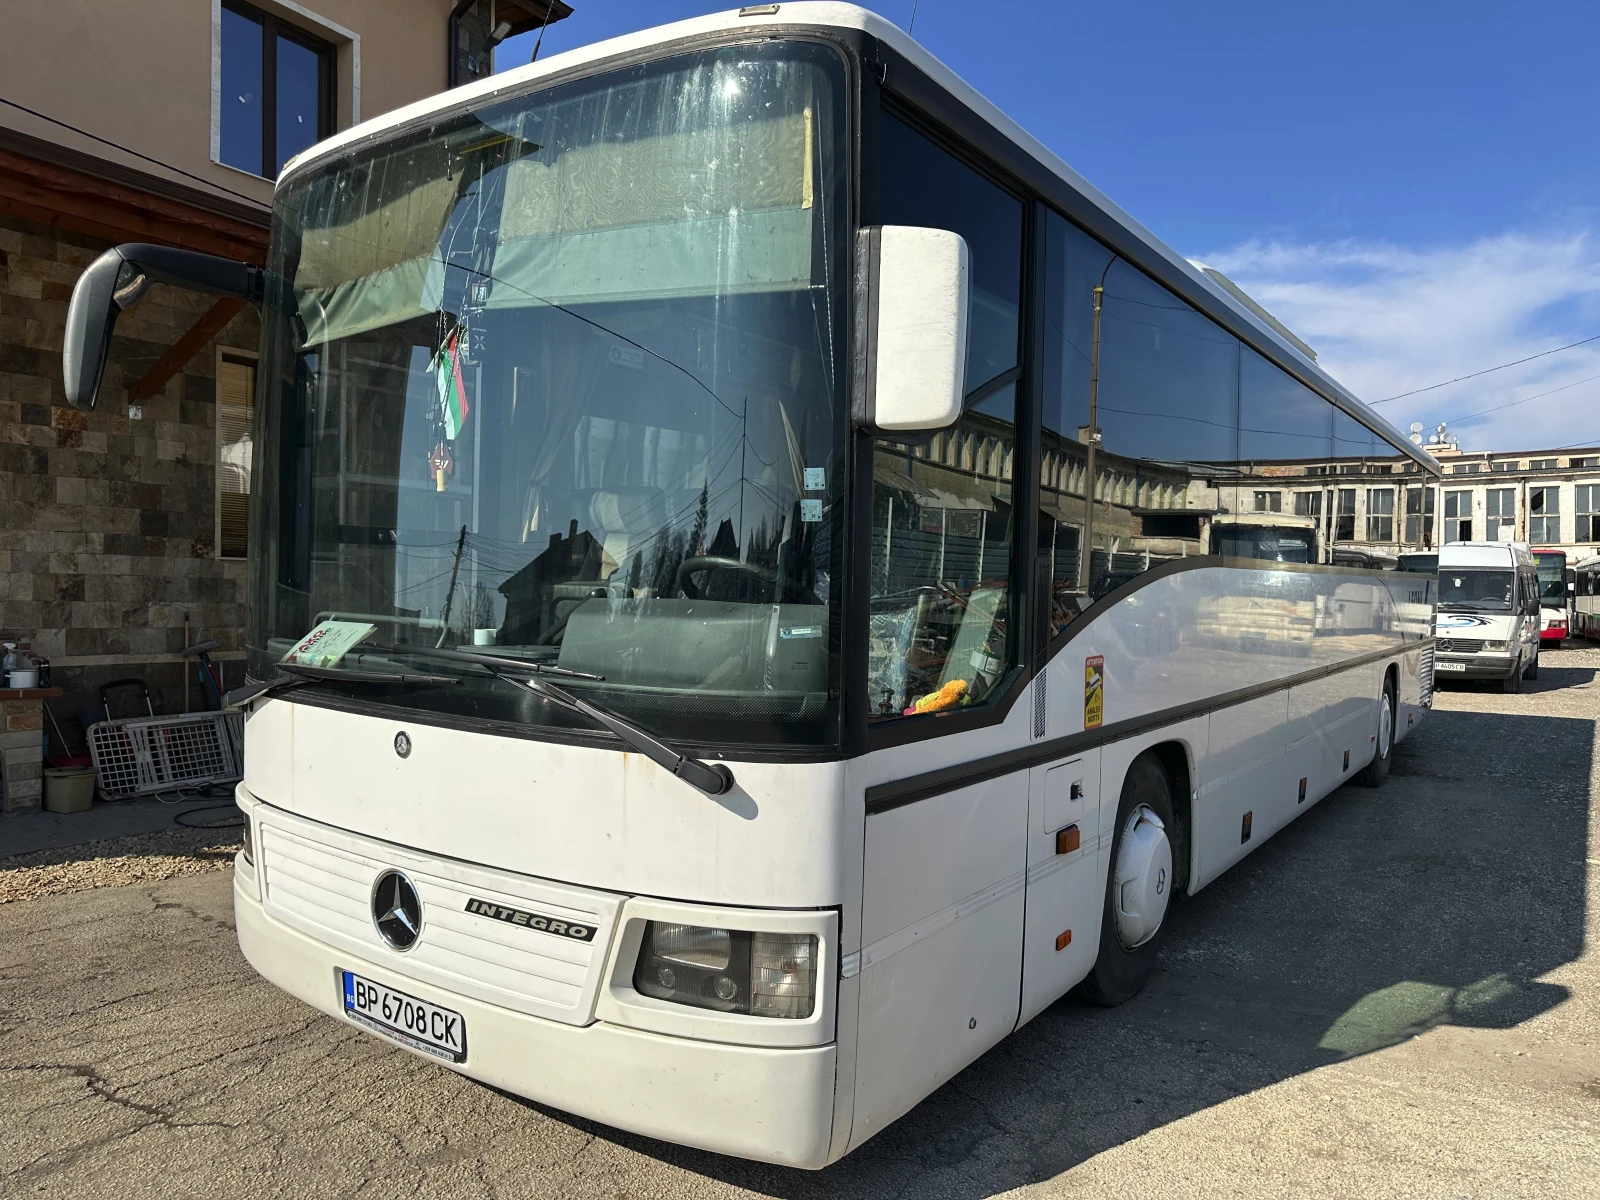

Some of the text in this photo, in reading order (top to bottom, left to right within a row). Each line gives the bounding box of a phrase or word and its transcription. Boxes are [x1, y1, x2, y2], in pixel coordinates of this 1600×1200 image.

[1087, 706, 1100, 715] ANGLES
[1087, 714, 1099, 723] MORTS
[470, 901, 588, 938] INTEGRO
[346, 993, 355, 1004] BG
[356, 980, 378, 1012] BP
[382, 992, 427, 1035] 6708
[431, 1011, 458, 1047] CK
